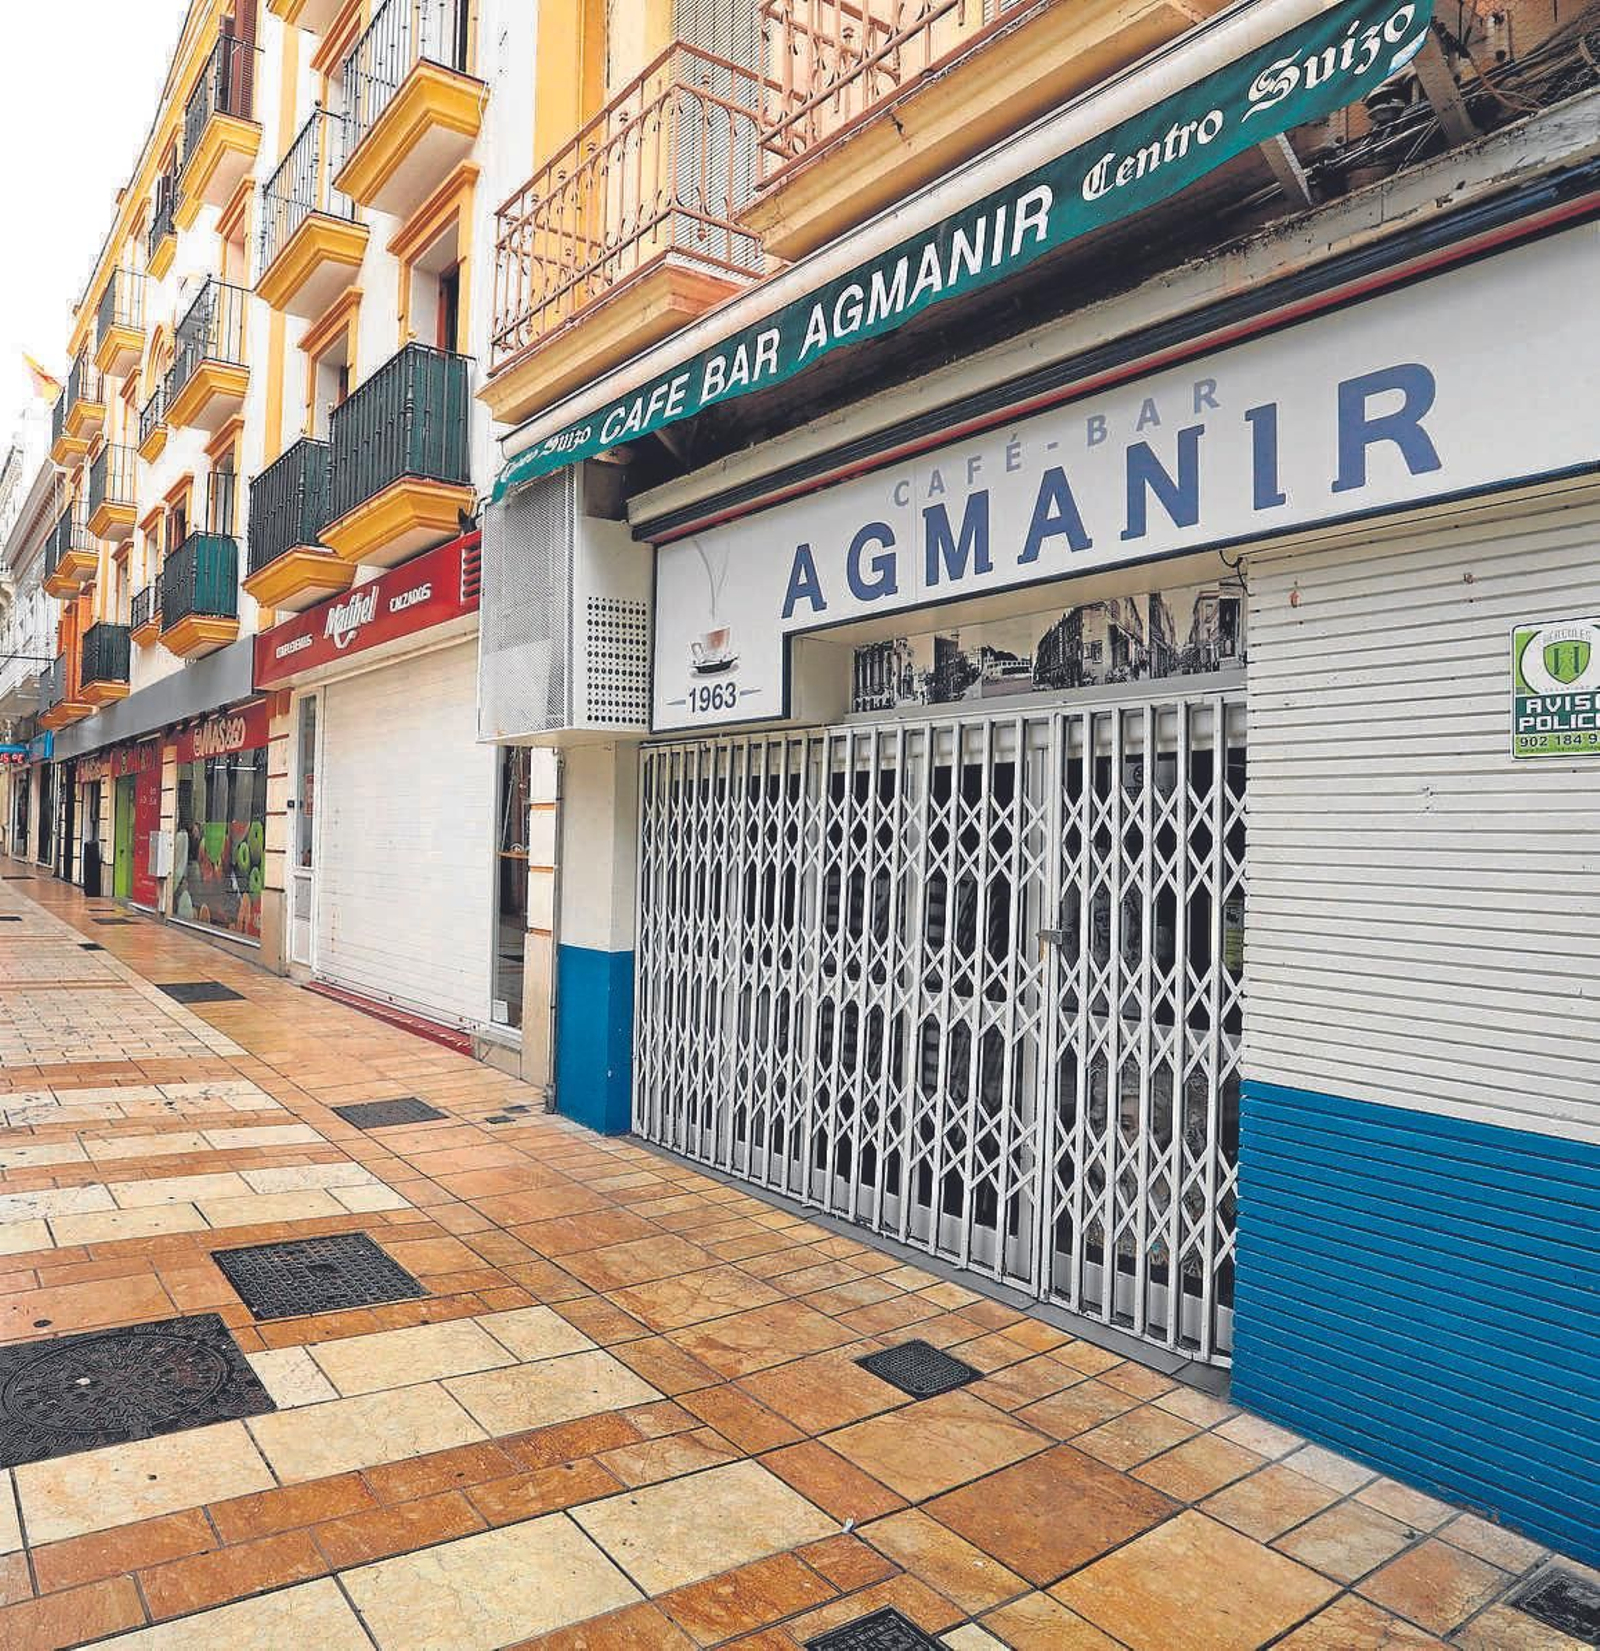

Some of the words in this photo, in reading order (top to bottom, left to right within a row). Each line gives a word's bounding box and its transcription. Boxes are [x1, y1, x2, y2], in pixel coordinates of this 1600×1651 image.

[600, 372, 690, 445] CAFE
[699, 328, 780, 405] BAR
[799, 184, 1053, 361] AGMANIR
[1081, 109, 1224, 201] Centro
[1241, 3, 1416, 123] Suizo
[781, 363, 1442, 619] AGMANIR
[689, 682, 737, 713] 1963
[1526, 694, 1600, 715] AVIS
[1519, 713, 1600, 732] POLIC
[1520, 736, 1548, 748] 902
[1556, 734, 1583, 746] 184
